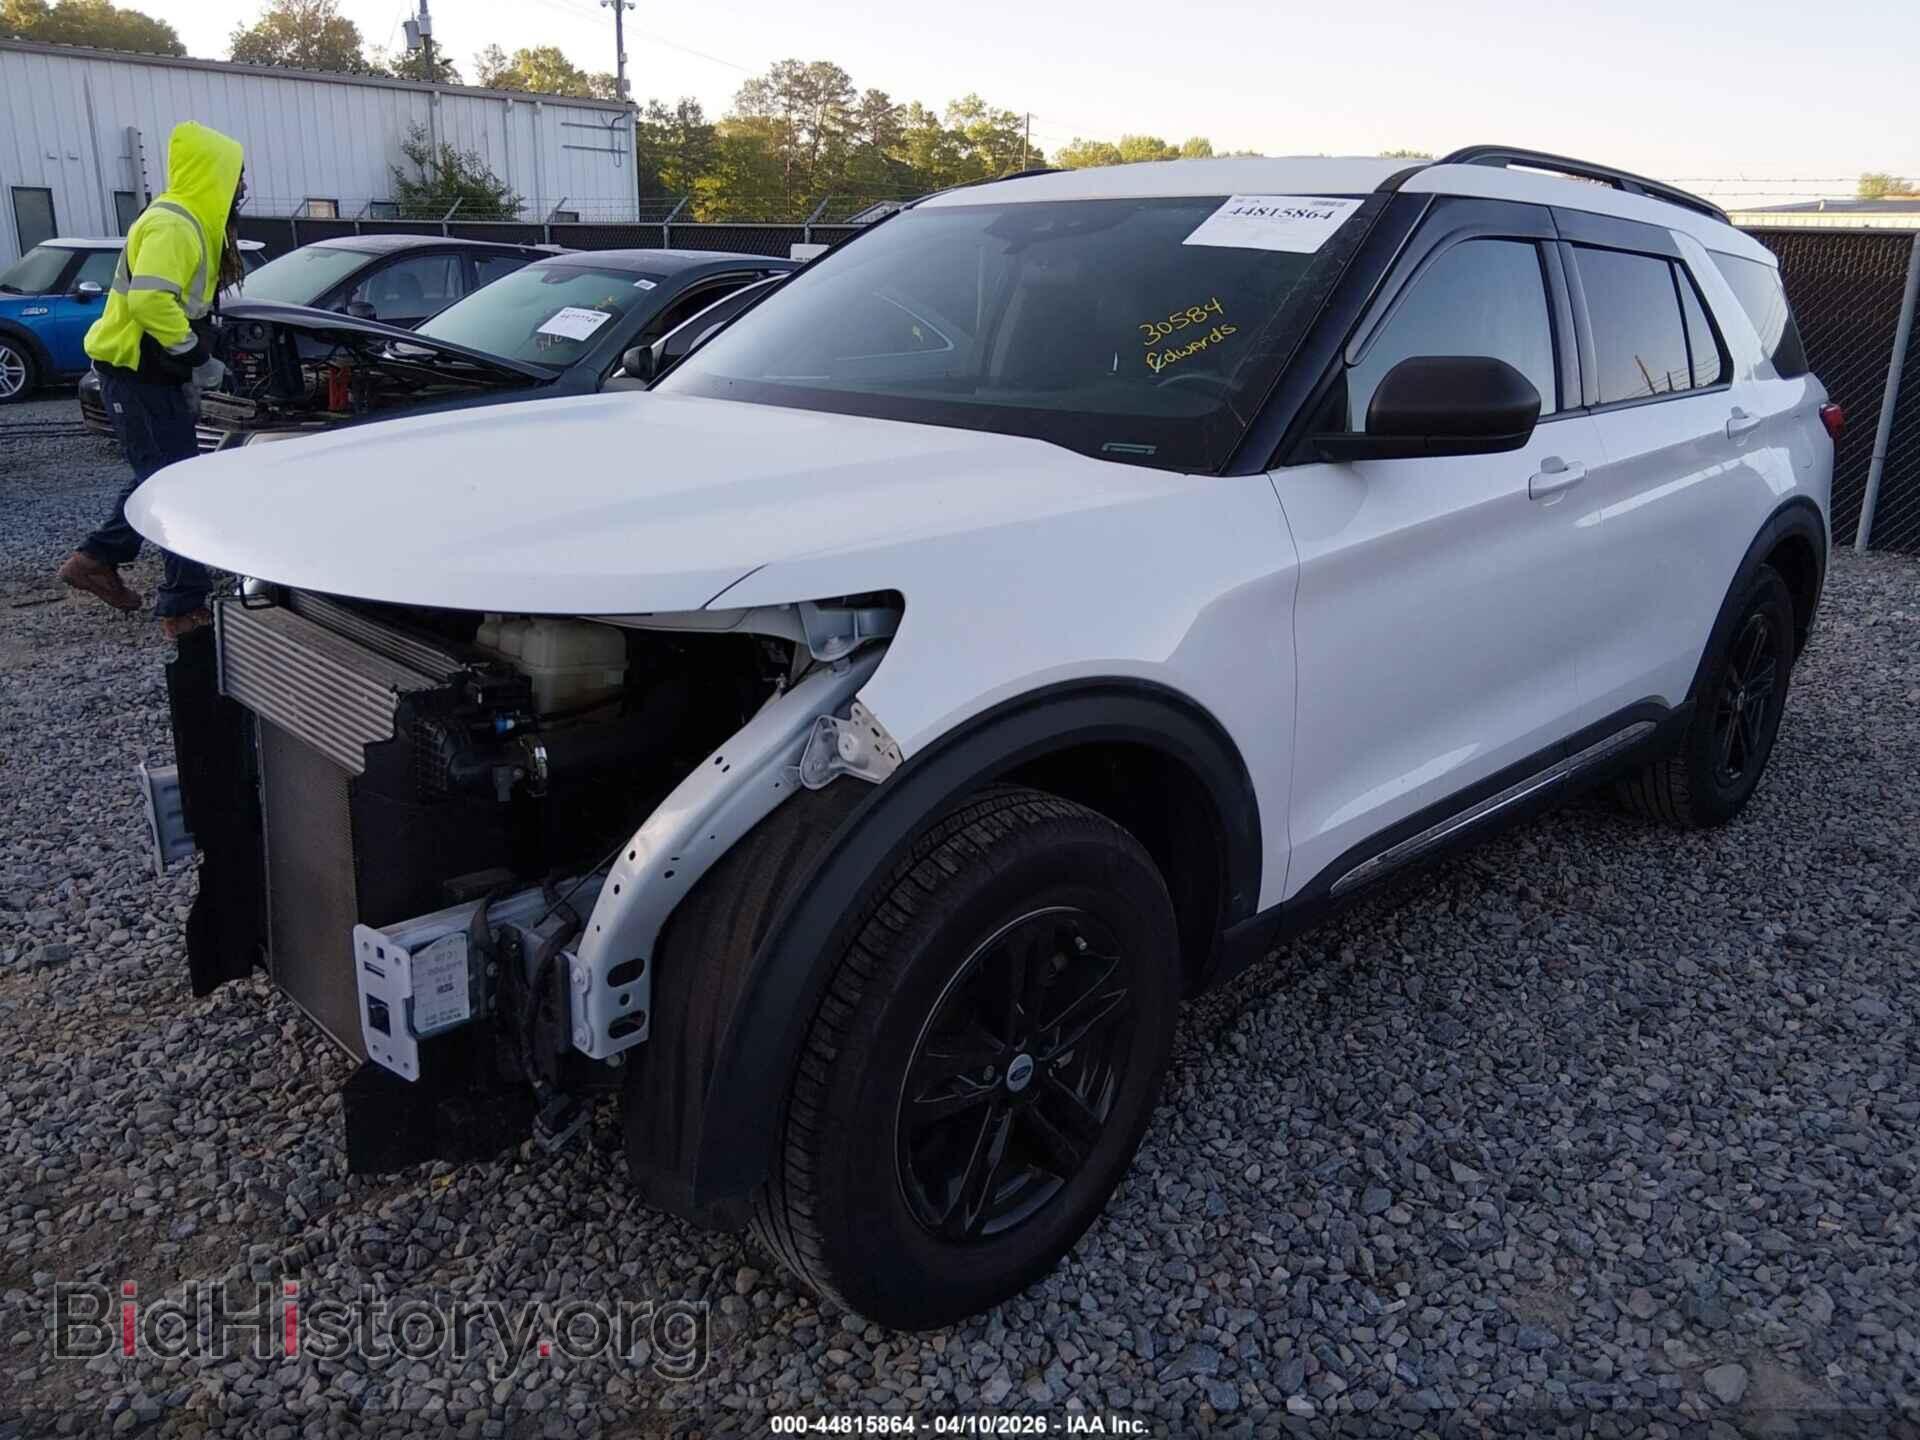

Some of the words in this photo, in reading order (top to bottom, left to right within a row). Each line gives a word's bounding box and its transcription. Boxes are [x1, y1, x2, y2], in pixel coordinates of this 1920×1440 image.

[1228, 206, 1336, 221] 44815864
[1139, 297, 1224, 346] 30584
[1146, 323, 1238, 374] Edwards
